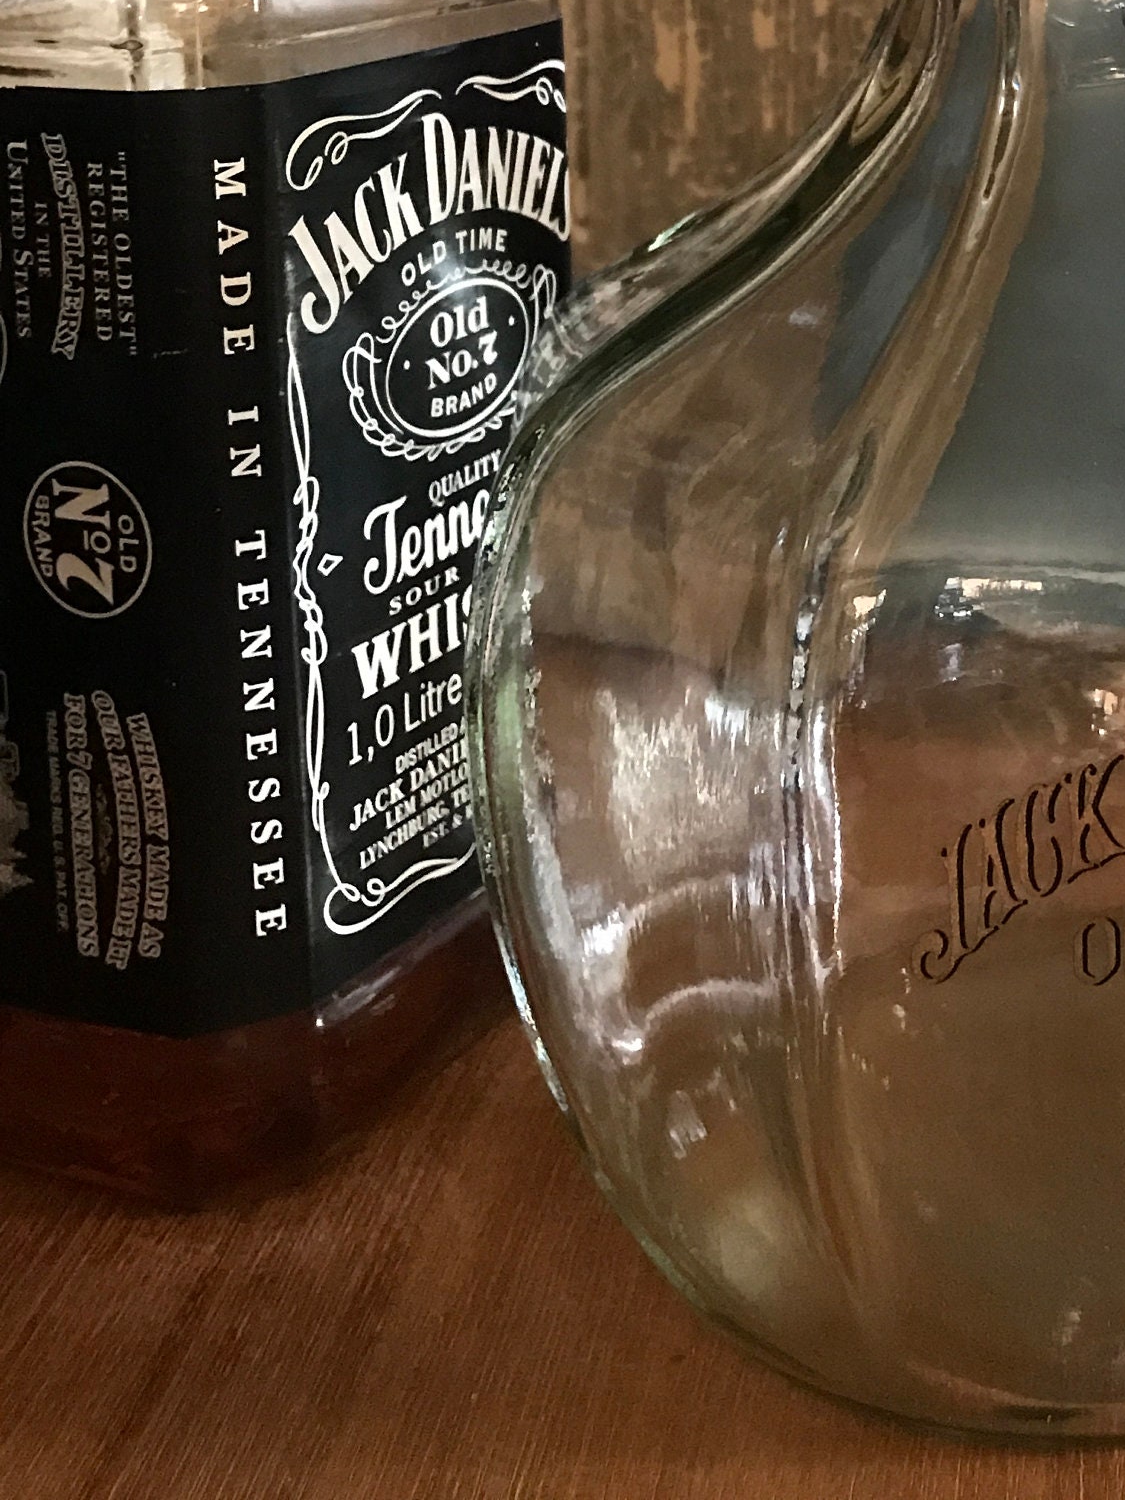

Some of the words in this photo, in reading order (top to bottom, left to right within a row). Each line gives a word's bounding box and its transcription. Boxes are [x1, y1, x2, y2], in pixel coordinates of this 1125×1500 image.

[34, 202, 49, 226] IN
[288, 152, 425, 334] JACK
[35, 235, 51, 278] THE
[40, 132, 85, 361] DISTILLERY
[87, 162, 114, 342] REGISTERED
[213, 157, 256, 355] MADE
[401, 240, 447, 287] OLD
[455, 227, 508, 255] TIME
[430, 296, 490, 348] Old
[430, 372, 498, 418] BRAND
[228, 405, 262, 478] IN
[429, 448, 501, 506] QUALITY
[32, 495, 54, 578] BRAND
[117, 514, 139, 573] OLD
[388, 566, 461, 616] SOUR
[64, 692, 88, 750] FOR
[91, 690, 126, 750] OUR
[235, 529, 287, 937] TENNESSEE
[404, 673, 463, 733] Litre
[126, 712, 169, 841] WHISKEY
[395, 722, 459, 775] DISTILLED
[107, 752, 142, 865] FATHERS
[349, 778, 406, 832] JACK
[68, 769, 100, 957] GENERATIONS
[145, 844, 170, 921] MADE
[112, 865, 142, 938] MADE
[105, 936, 132, 971] IT
[138, 921, 164, 958] AS
